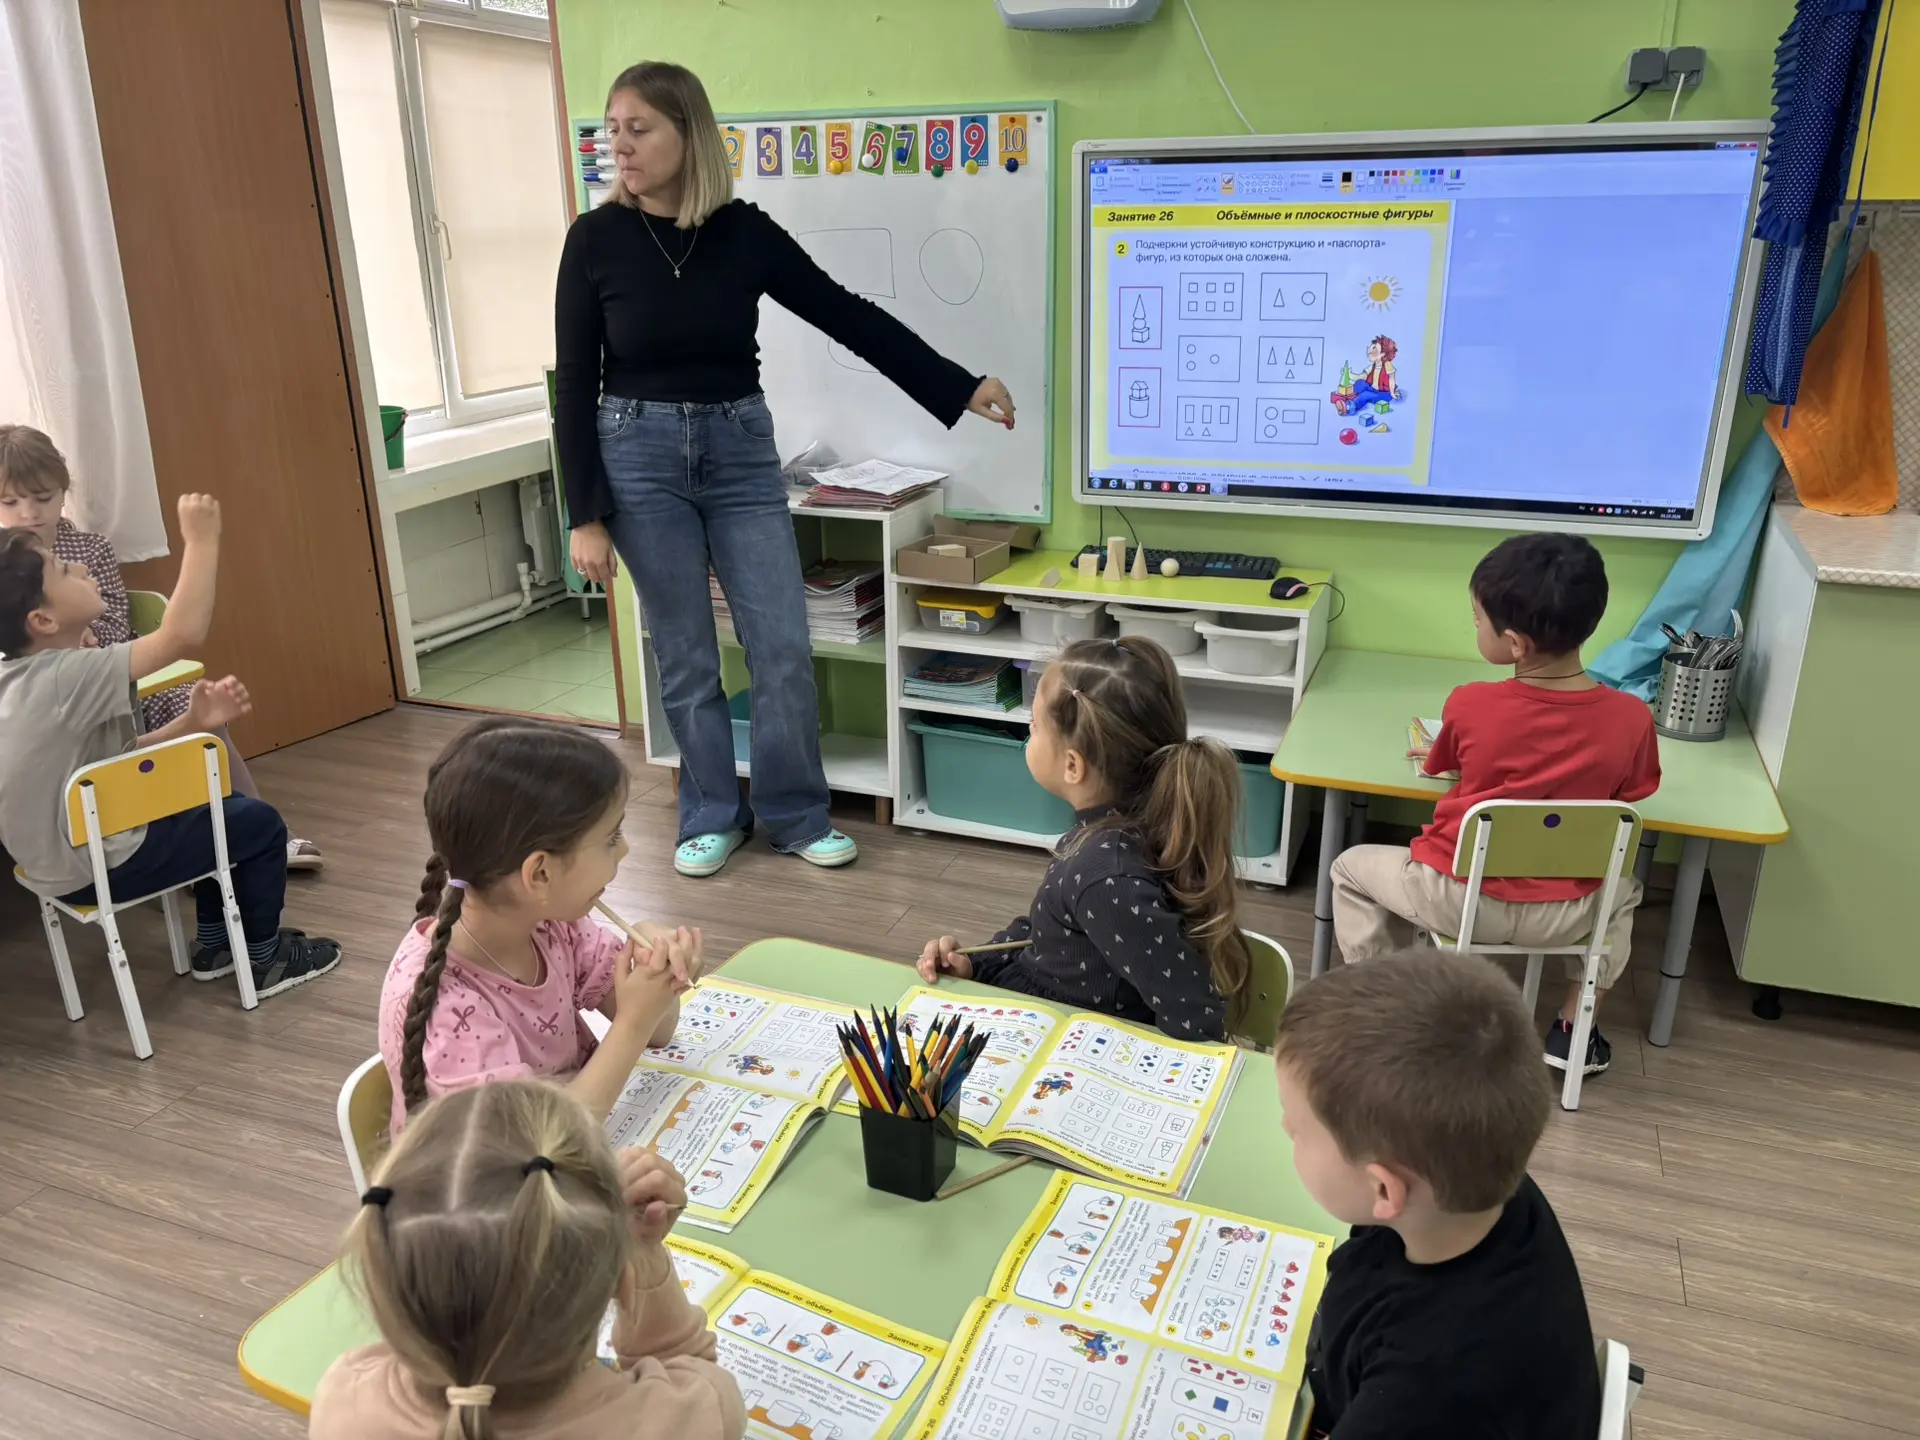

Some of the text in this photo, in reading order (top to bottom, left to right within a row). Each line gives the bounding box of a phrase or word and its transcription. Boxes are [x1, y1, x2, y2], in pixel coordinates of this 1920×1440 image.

[724, 122, 1026, 172] 2 3 4 5 6 7 8 9 10
[1107, 211, 1157, 222] Занятие
[1159, 211, 1174, 221] 26
[1216, 209, 1282, 221] Объёмные
[1295, 210, 1380, 220] плоскостные
[1382, 208, 1433, 221] фигуры
[1117, 244, 1125, 254] 2
[1136, 240, 1188, 250] Подчеркни
[1190, 240, 1248, 250] устойчивую
[1250, 239, 1316, 250] конструкцию
[1327, 239, 1386, 250] «паспорта»
[1136, 252, 1292, 264] фигур, из которых она сложена.
[1000, 1256, 1020, 1292] Сравнение
[1018, 1247, 1025, 1255] по
[1049, 1186, 1063, 1205] Занятие
[707, 1253, 734, 1270] фигуры
[752, 1278, 789, 1295] Сравнение
[805, 1300, 832, 1313] объёму
[887, 1332, 918, 1347] Занятие
[926, 1418, 936, 1427] 26
[937, 1365, 960, 1405] Объёмные
[962, 1309, 986, 1353] плоскостные
